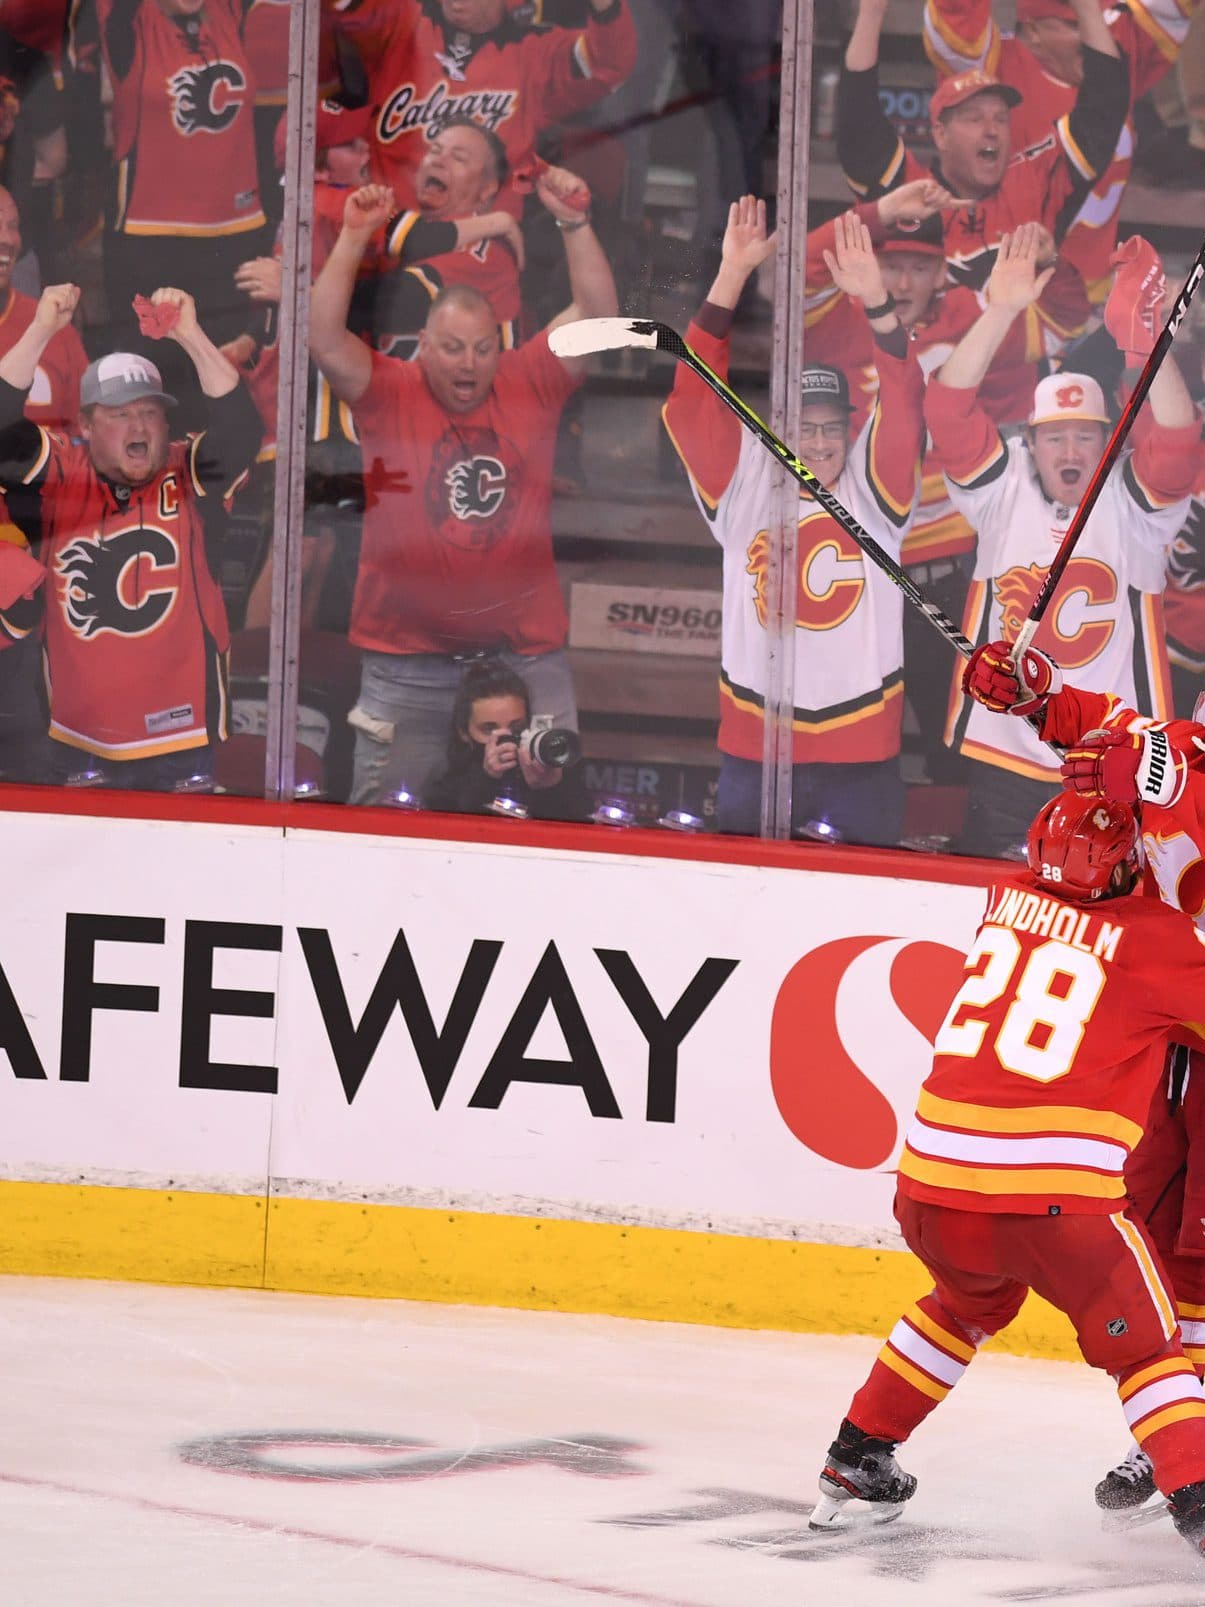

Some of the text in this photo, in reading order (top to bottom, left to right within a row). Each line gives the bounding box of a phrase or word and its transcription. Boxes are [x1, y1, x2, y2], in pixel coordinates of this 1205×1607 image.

[167, 59, 245, 137] C
[377, 81, 517, 144] Calgary
[158, 472, 178, 520] C
[444, 455, 506, 519] C
[787, 457, 871, 544] ALPHA LX
[56, 526, 180, 640] C
[608, 603, 722, 630] SN960
[1145, 730, 1167, 796] RRIOR
[1042, 863, 1063, 882] 28
[985, 884, 1124, 963] LINDHOLM
[934, 924, 1107, 1083] 28
